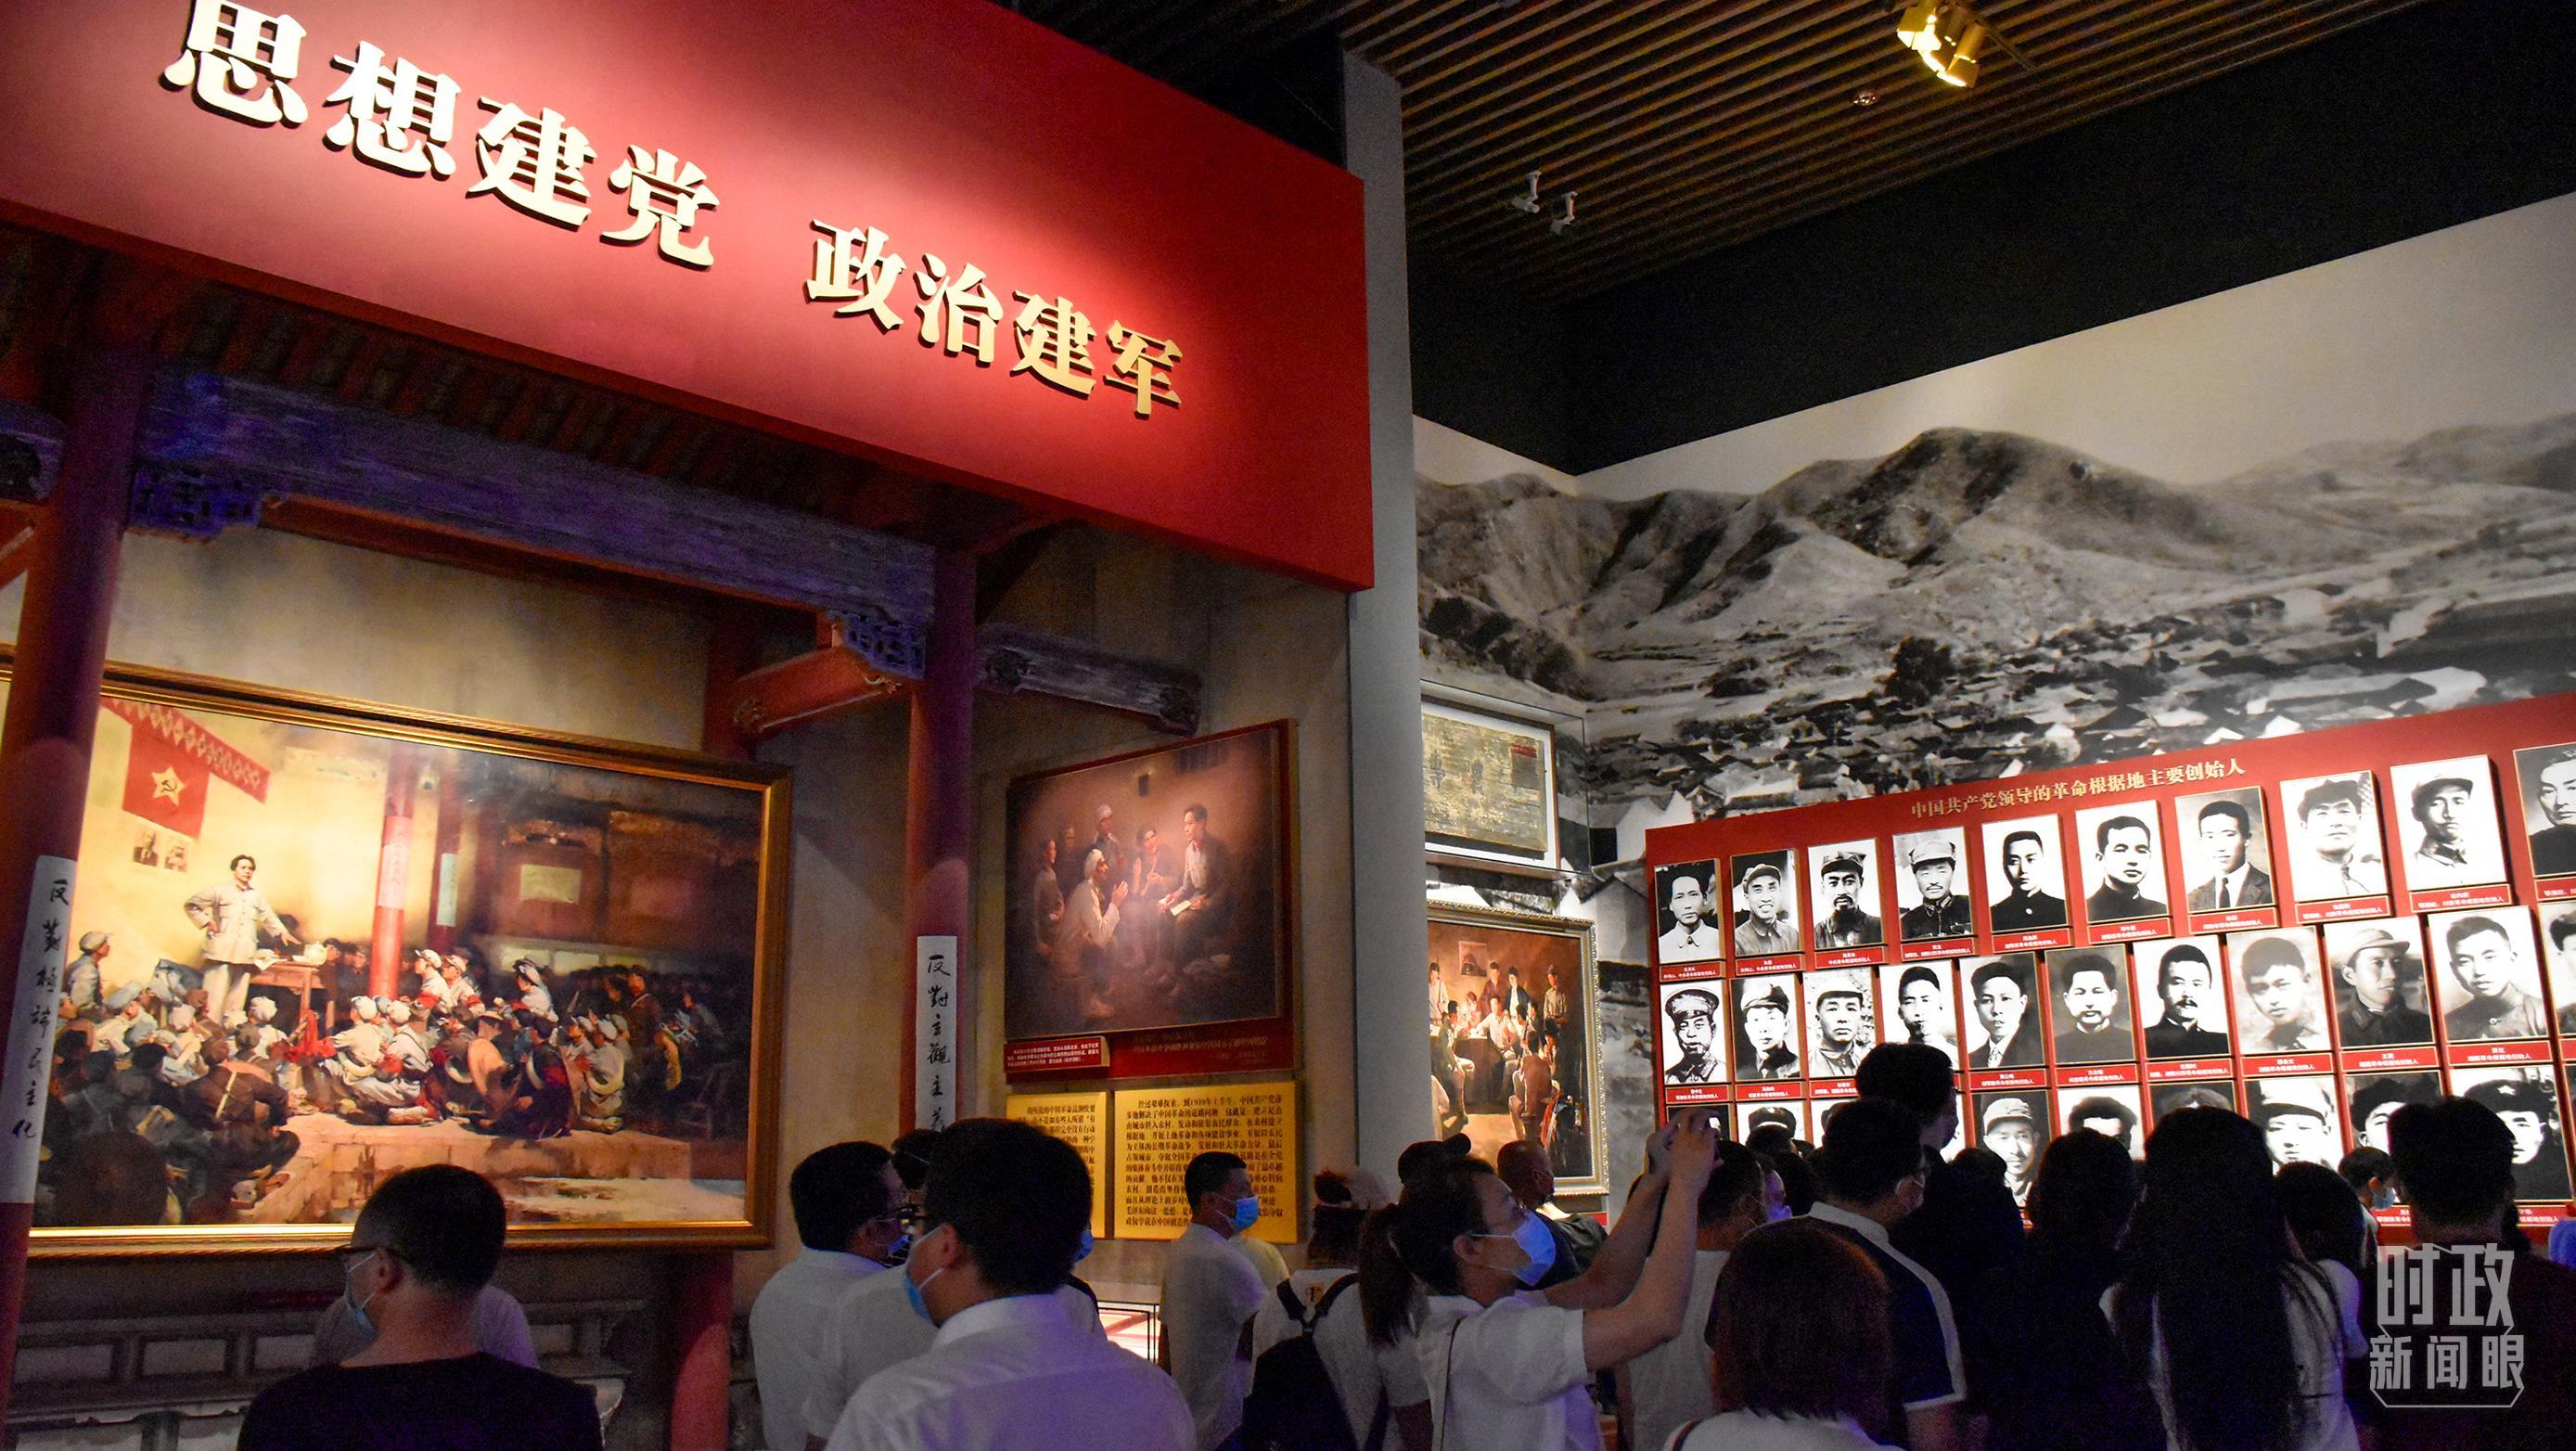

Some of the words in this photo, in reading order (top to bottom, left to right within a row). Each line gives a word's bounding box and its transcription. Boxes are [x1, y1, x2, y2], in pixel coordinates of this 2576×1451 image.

[160, 0, 720, 268] 思想建党
[805, 219, 1183, 419] 政治建军
[1911, 757, 2246, 818] 中国共产党领导的革命根据地主要创始人
